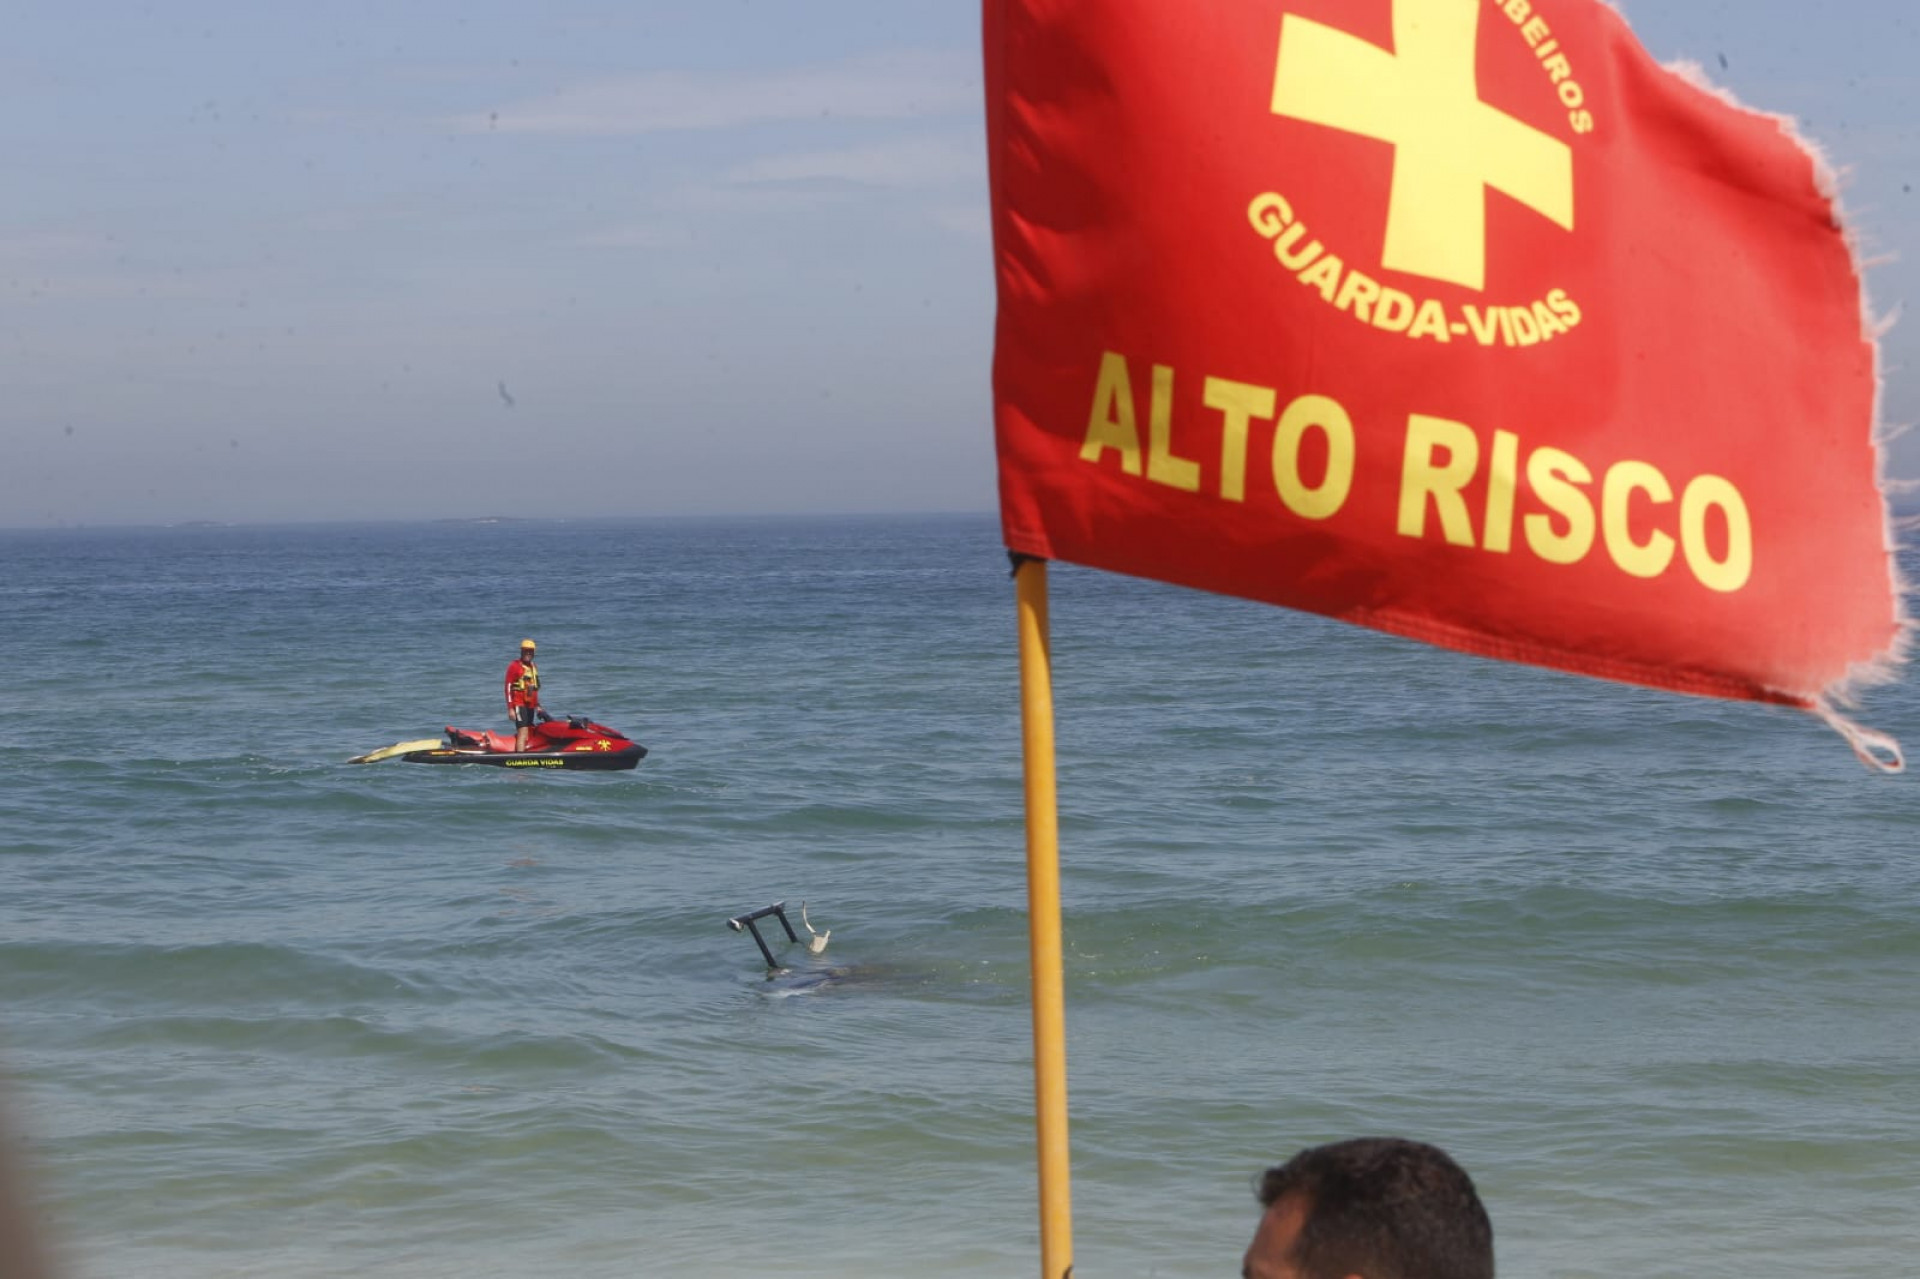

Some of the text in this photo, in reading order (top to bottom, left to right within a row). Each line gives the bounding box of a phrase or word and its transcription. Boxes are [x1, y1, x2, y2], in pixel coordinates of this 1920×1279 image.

[1494, 0, 1594, 134] BEIROS
[1247, 191, 1582, 347] GUARDA-VIDAS
[1079, 350, 1753, 592] ALTO RISCO
[505, 759, 540, 767] GUARDA
